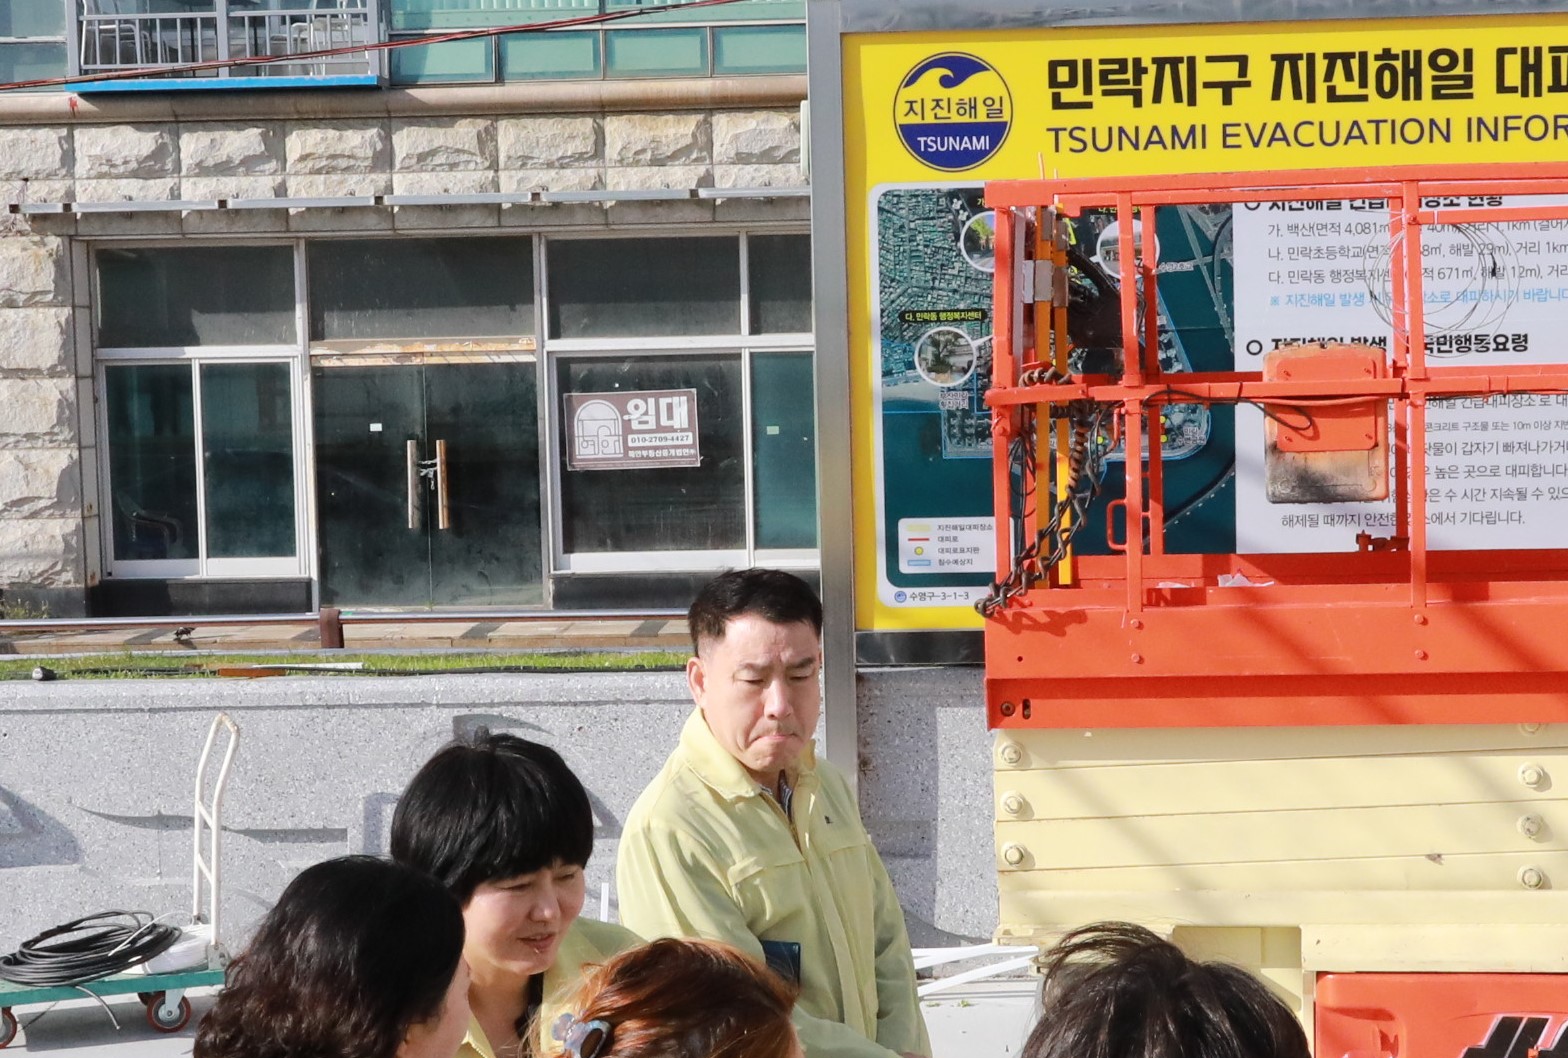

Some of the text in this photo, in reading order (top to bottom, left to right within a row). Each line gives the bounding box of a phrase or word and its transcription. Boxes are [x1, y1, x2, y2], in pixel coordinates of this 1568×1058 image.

[1047, 53, 1251, 111] 민락지구
[1271, 46, 1474, 104] 지진해일
[903, 96, 1005, 122] 지진해일
[1047, 124, 1207, 154] TSUNAMI
[1222, 117, 1451, 150] EVACUATION
[916, 135, 991, 154] TSUNAMI
[1268, 223, 1284, 238] 가.
[1287, 221, 1341, 238] 백산(면적
[1268, 246, 1284, 261] 나.
[1516, 241, 1541, 256] 거리
[1268, 271, 1284, 285] 다.
[1287, 268, 1325, 285] 민락동
[1285, 292, 1336, 308] 지진해일
[1340, 291, 1365, 308] 발생
[626, 396, 689, 430] 임대
[1513, 419, 1531, 432] 10m
[1533, 418, 1551, 432] 이상
[630, 434, 690, 445] 010-2709-4427
[1461, 440, 1499, 456] 갑자기
[1433, 464, 1460, 480] 높은
[1463, 463, 1501, 480] 곳으로
[1444, 488, 1458, 503] 수
[1461, 487, 1486, 503] 시간
[1490, 486, 1528, 502] 지속될
[1531, 486, 1544, 502] 수
[1280, 513, 1320, 529] 해제될
[1323, 512, 1361, 528] 때까지
[1460, 509, 1526, 526] 기다립니다.
